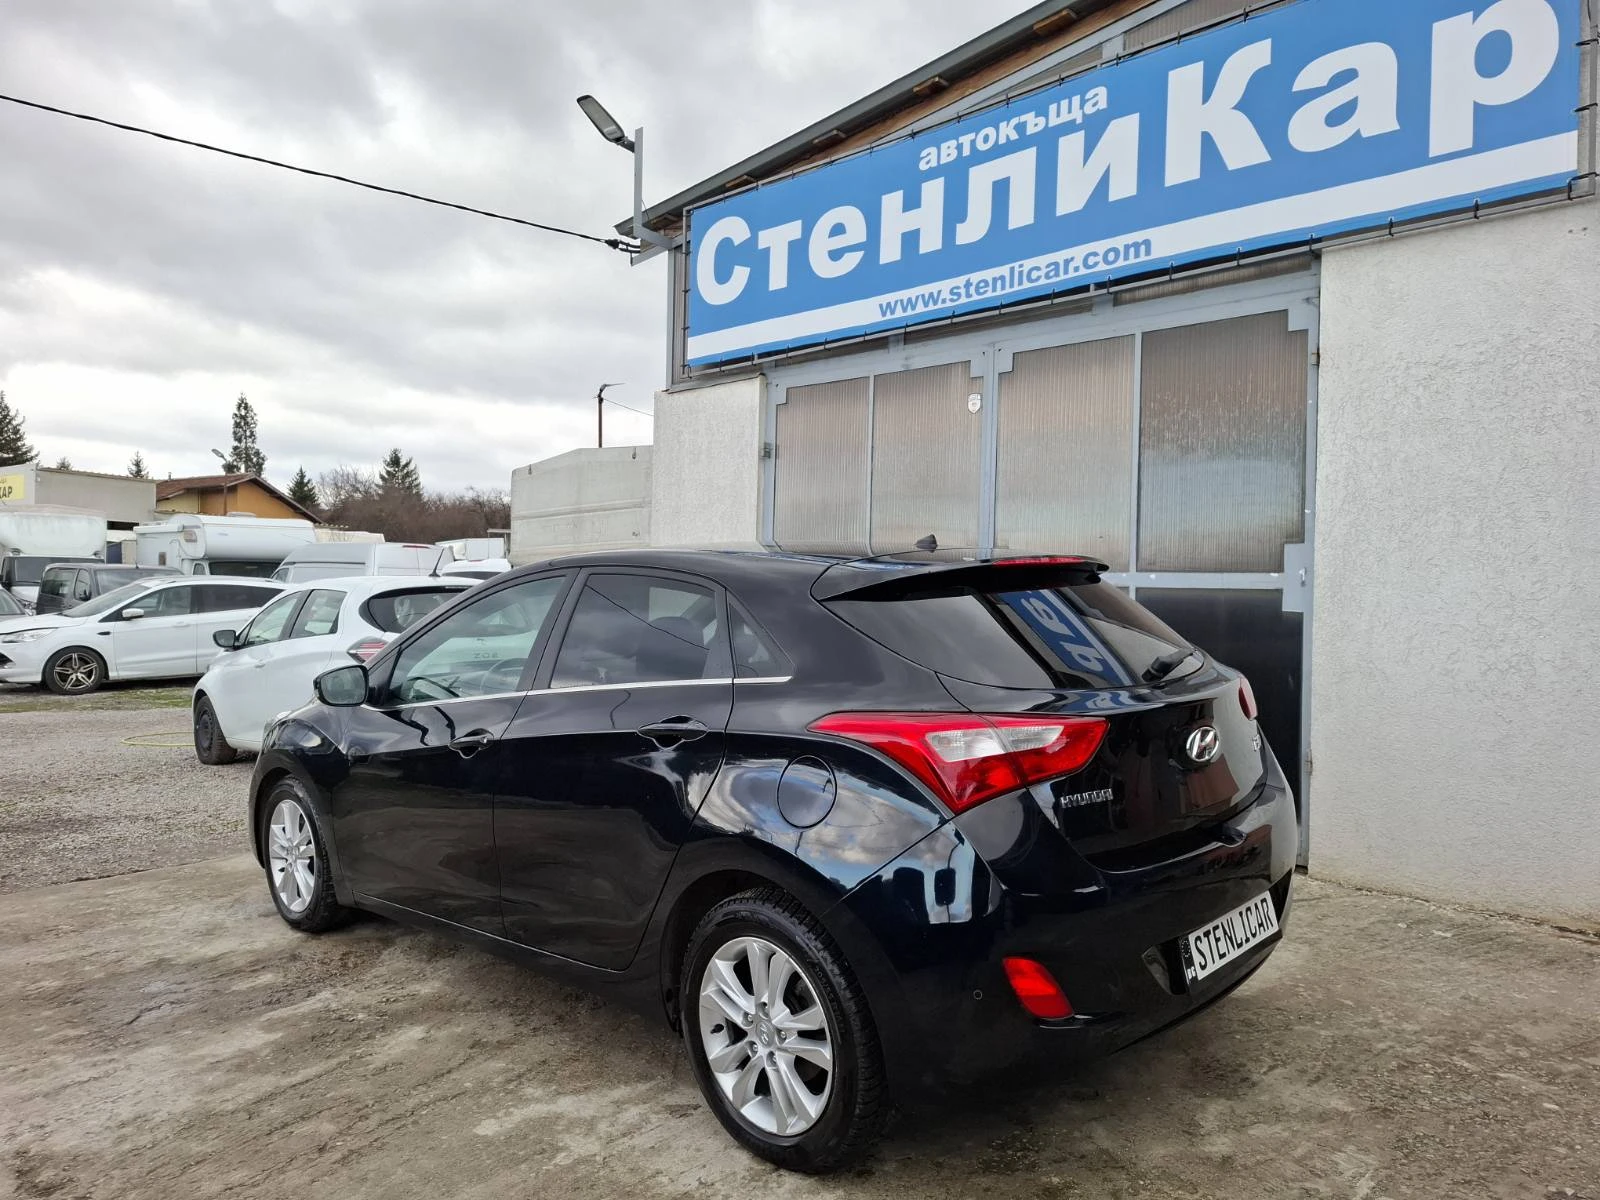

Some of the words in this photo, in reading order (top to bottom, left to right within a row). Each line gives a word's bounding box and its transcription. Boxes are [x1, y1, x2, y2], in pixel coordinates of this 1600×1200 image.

[696, 0, 1560, 306] СтенлиКар
[918, 85, 1108, 171] автокъща
[878, 237, 1152, 318] www.stenlicar.com
[1060, 788, 1114, 808] HYUNDAI
[1194, 897, 1274, 971] STENLICAR
